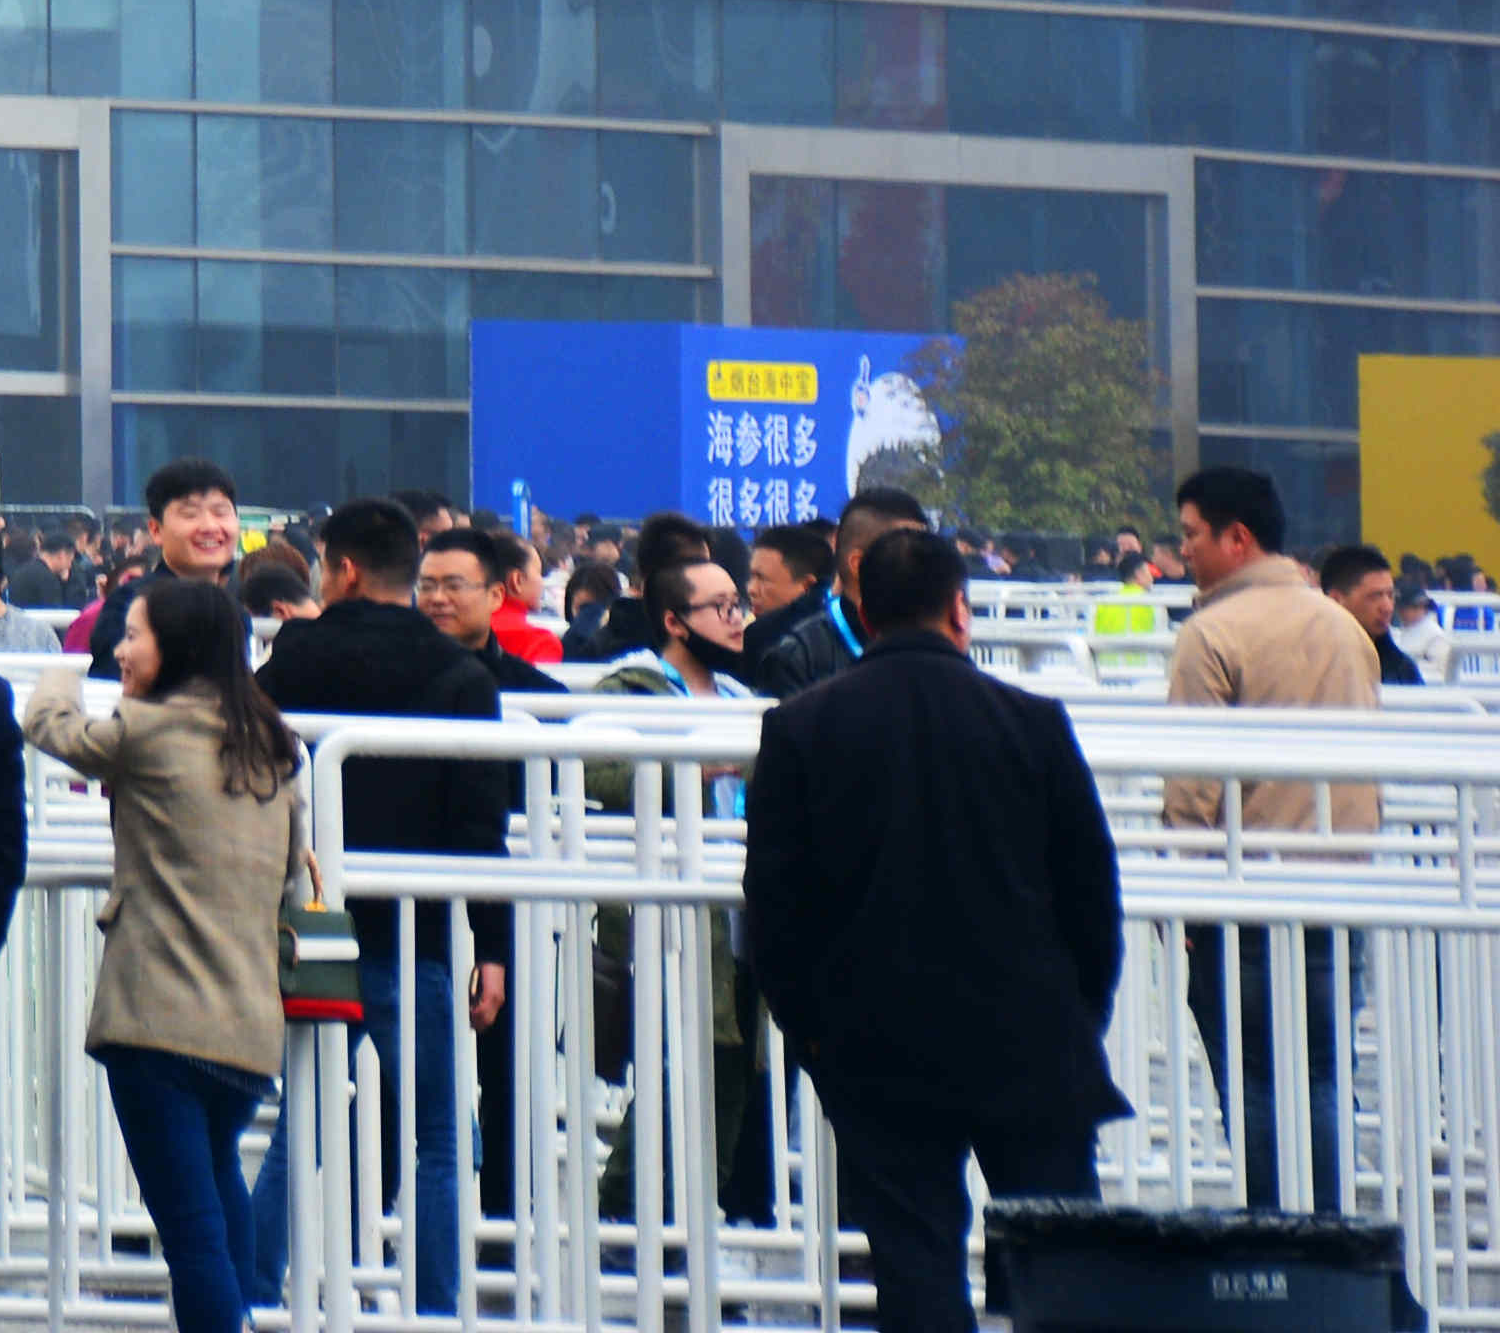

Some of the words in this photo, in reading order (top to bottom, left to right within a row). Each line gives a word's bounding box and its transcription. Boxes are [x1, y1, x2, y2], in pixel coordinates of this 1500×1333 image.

[707, 409, 818, 468] 海参很多
[707, 476, 819, 528] 很多很多
